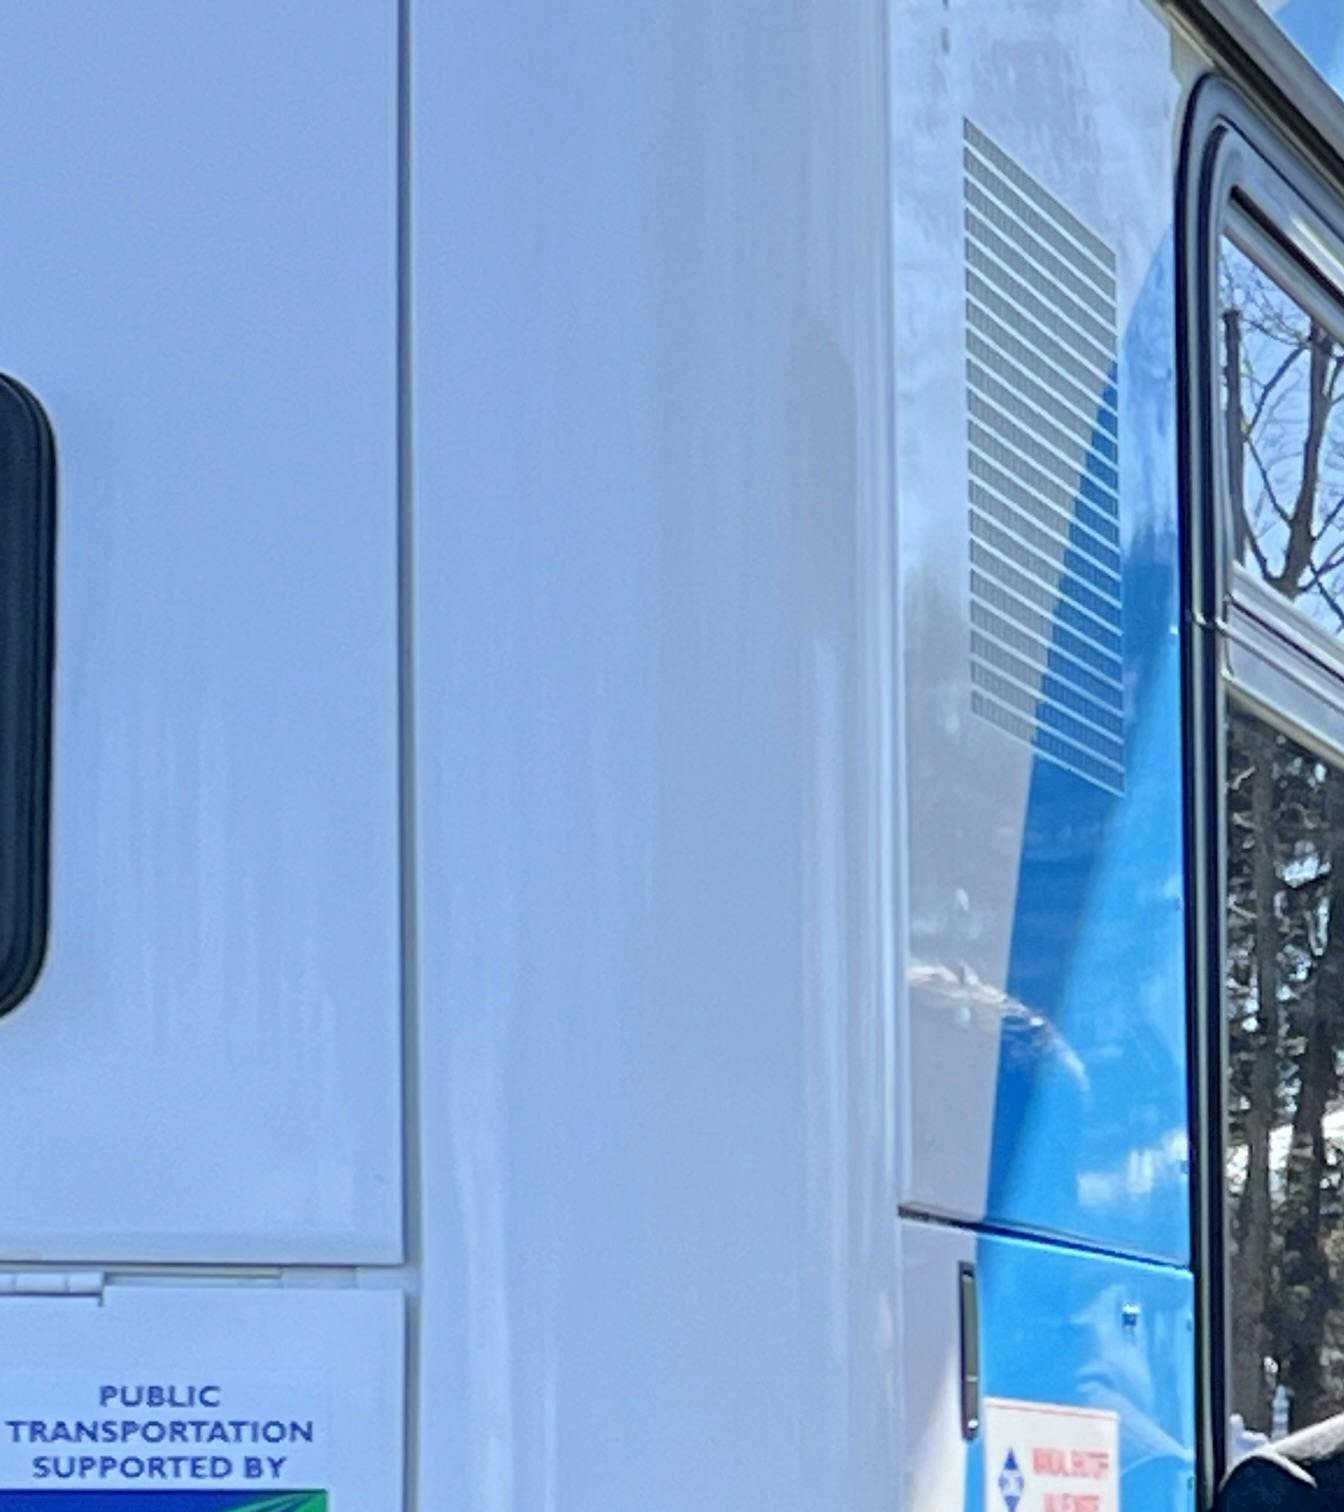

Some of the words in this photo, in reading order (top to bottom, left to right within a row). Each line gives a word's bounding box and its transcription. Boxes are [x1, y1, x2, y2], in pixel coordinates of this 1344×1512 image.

[99, 1384, 221, 1408] PUBLIC
[5, 1420, 314, 1444] TRANSPORTATION
[32, 1455, 233, 1480] SUPPORTED
[243, 1455, 287, 1480] BY
